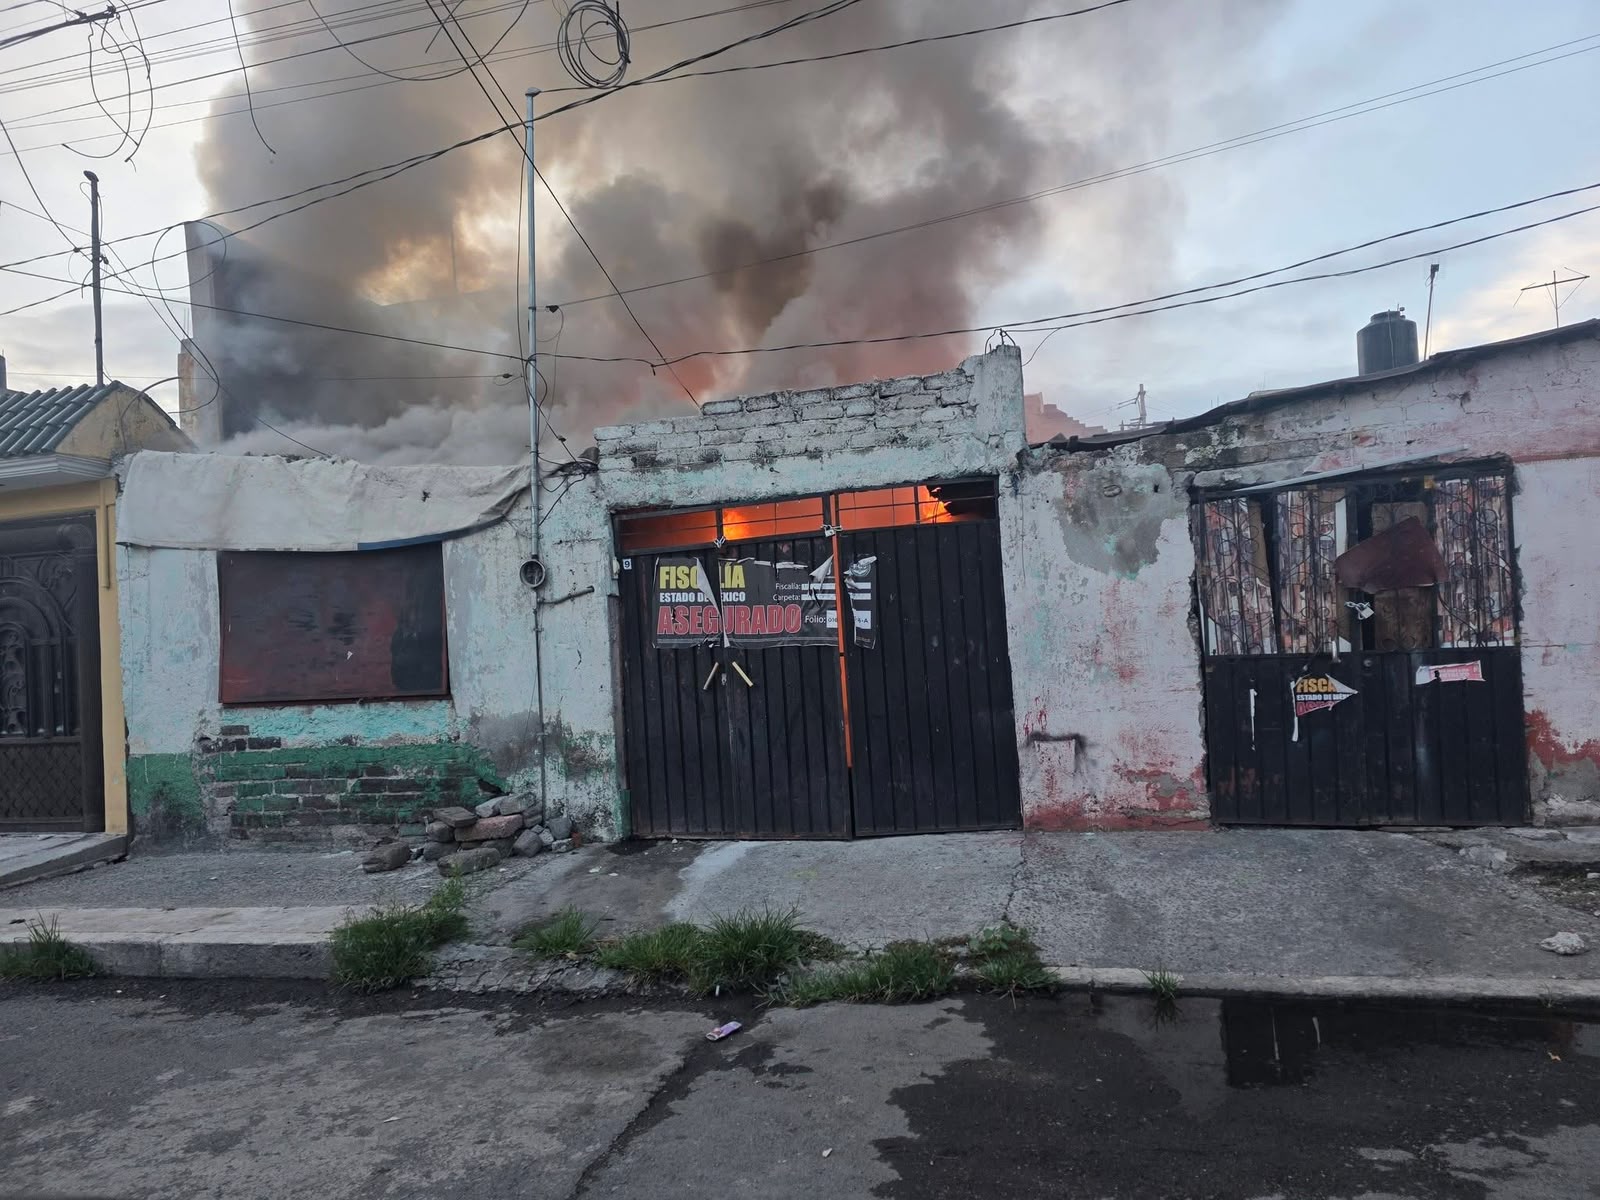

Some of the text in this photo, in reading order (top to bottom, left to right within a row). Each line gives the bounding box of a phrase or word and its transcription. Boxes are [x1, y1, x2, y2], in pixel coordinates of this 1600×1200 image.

[624, 560, 630, 568] 9
[659, 562, 745, 589] FISCÍA
[660, 592, 695, 602] ESTADO
[772, 594, 801, 602] Carpeta:
[657, 603, 802, 635] ASEGURADO
[804, 615, 826, 624] Folio:
